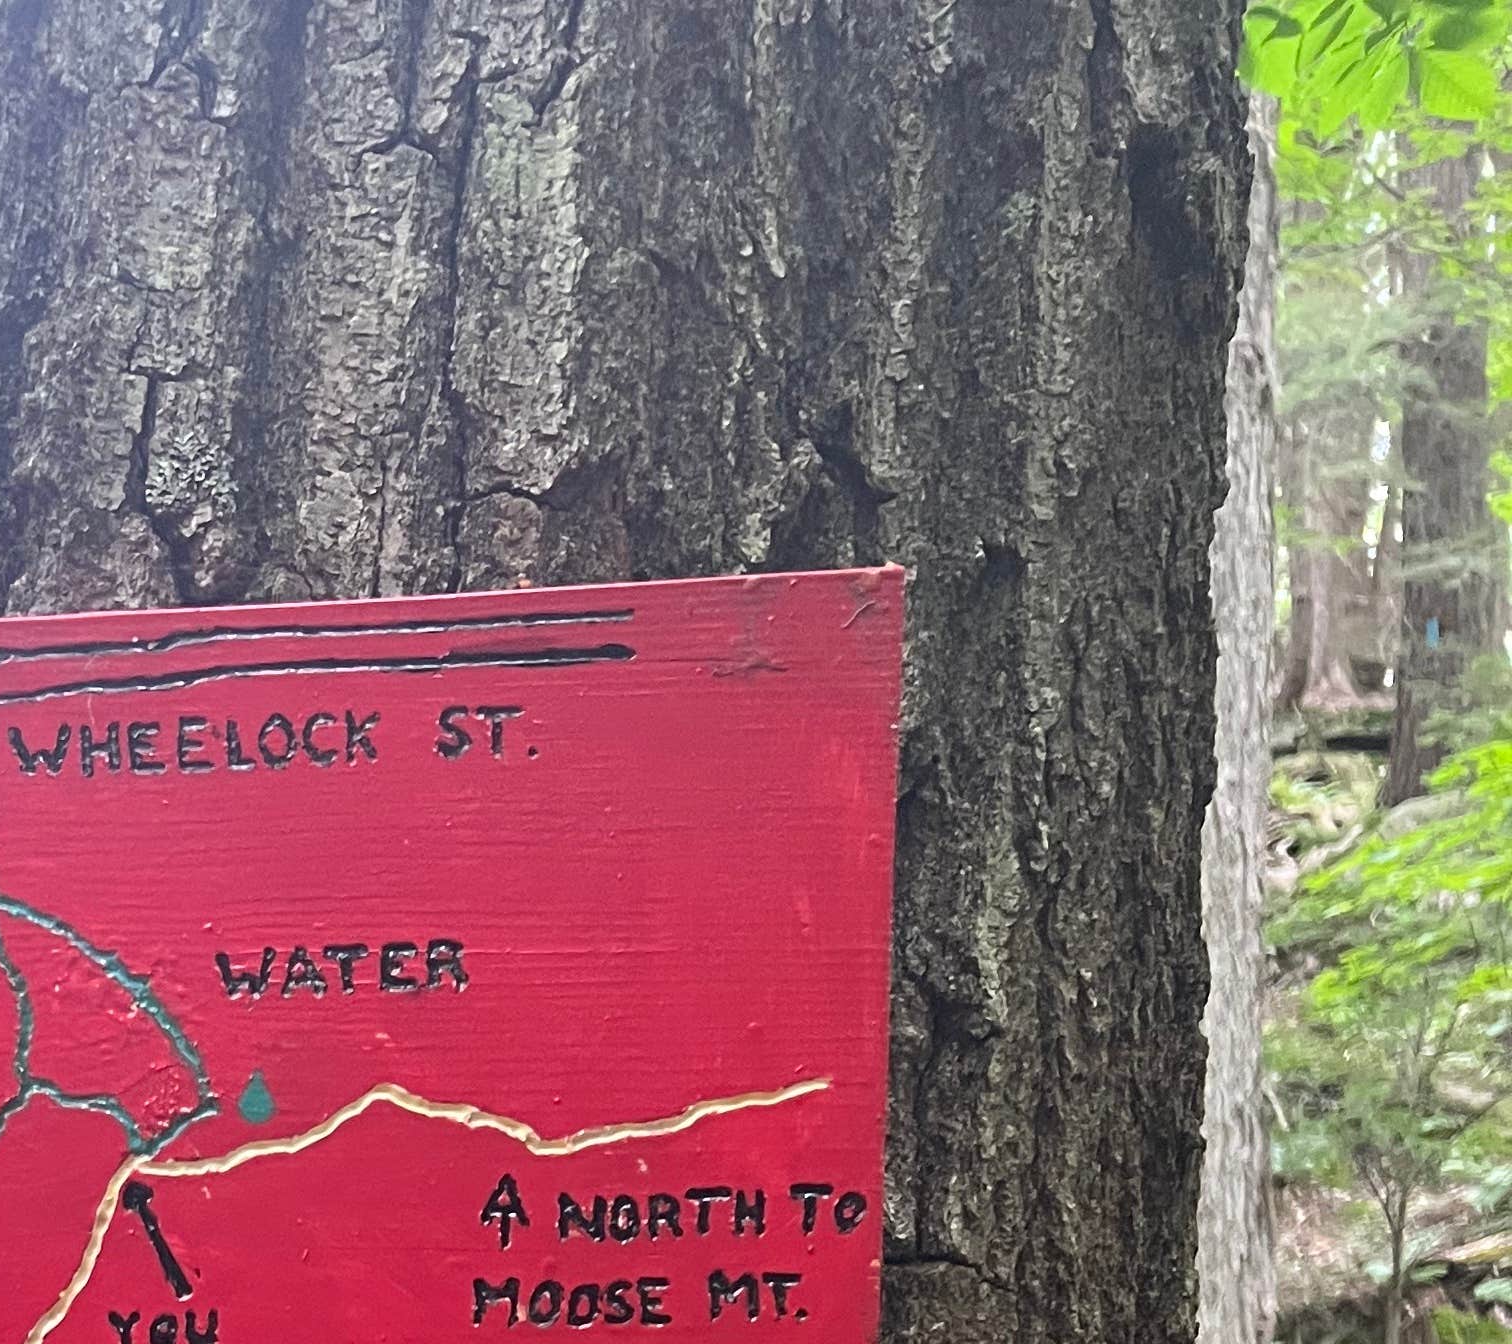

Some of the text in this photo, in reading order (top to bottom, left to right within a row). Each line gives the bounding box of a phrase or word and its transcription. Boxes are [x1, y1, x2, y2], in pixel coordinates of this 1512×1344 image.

[7, 708, 382, 779] WHEELOCK
[433, 704, 540, 764] ST.
[214, 938, 469, 1001] WATER
[556, 1182, 867, 1245] NORTH TO
[471, 1269, 809, 1330] MOOSE MT.
